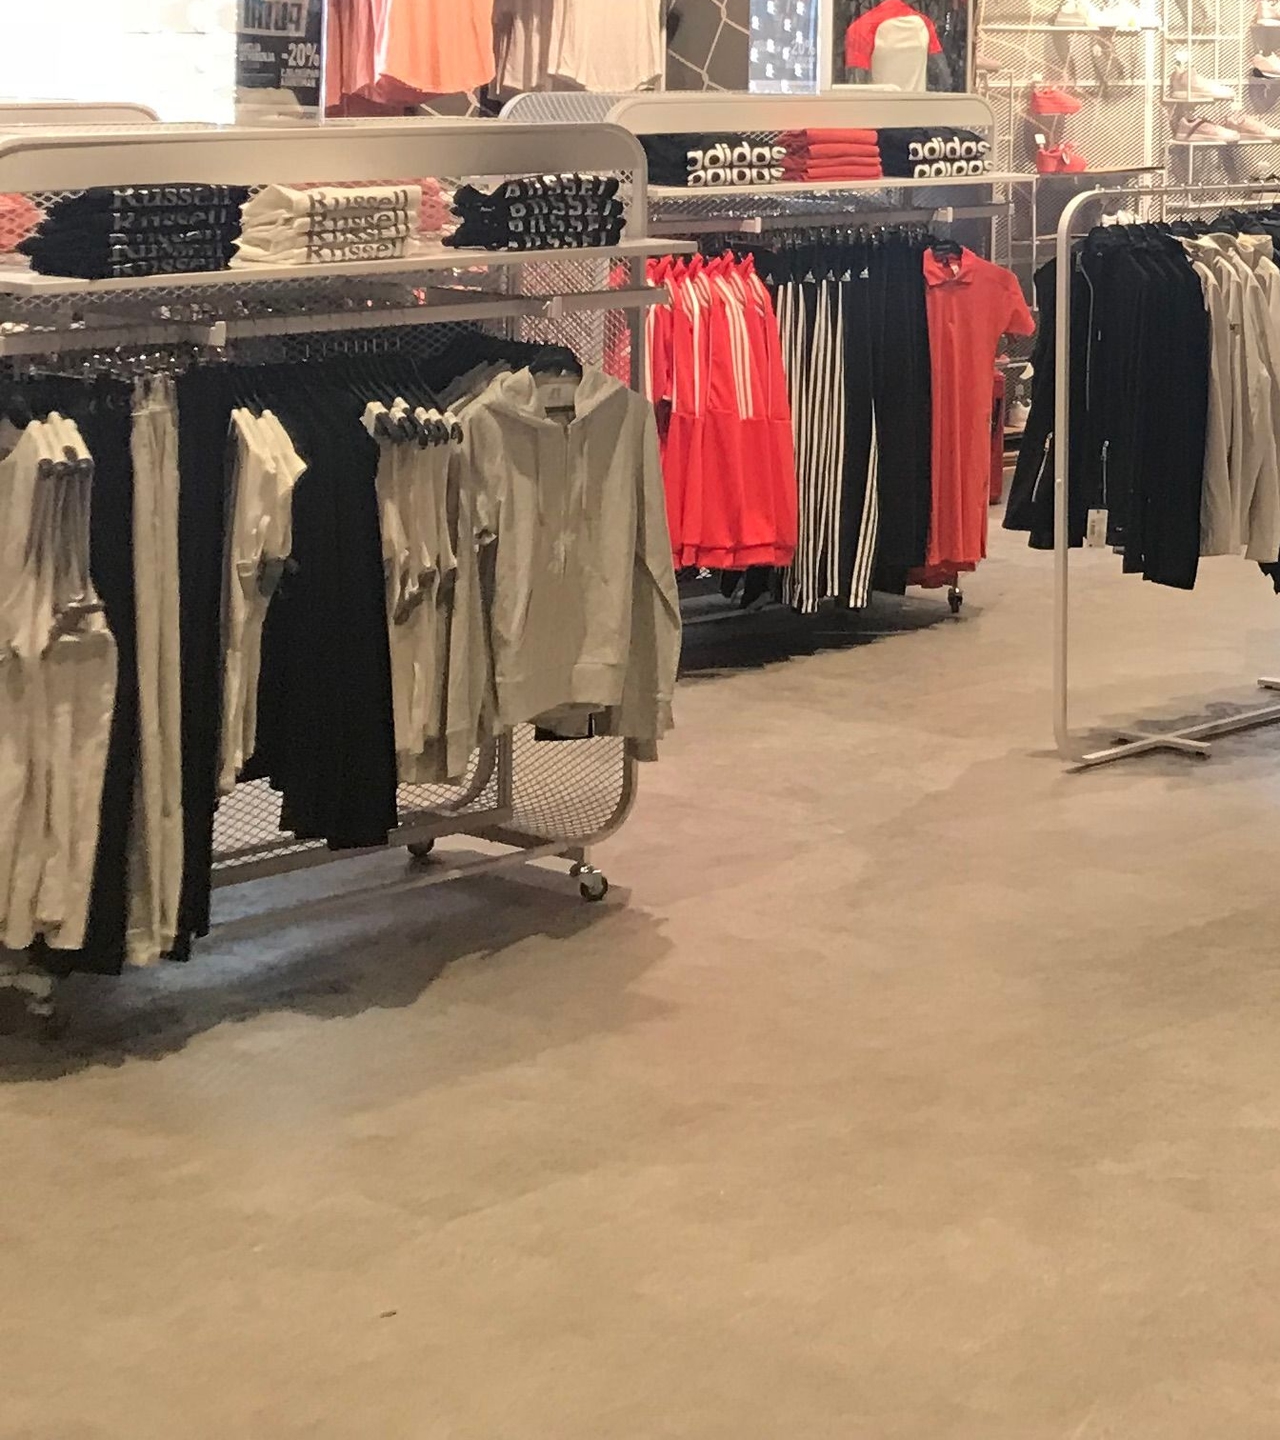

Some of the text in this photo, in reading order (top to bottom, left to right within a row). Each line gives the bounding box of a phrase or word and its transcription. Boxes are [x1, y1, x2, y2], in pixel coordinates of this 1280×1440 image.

[281, 42, 320, 67] -20%
[687, 143, 786, 171] adidas
[909, 136, 991, 160] adidas
